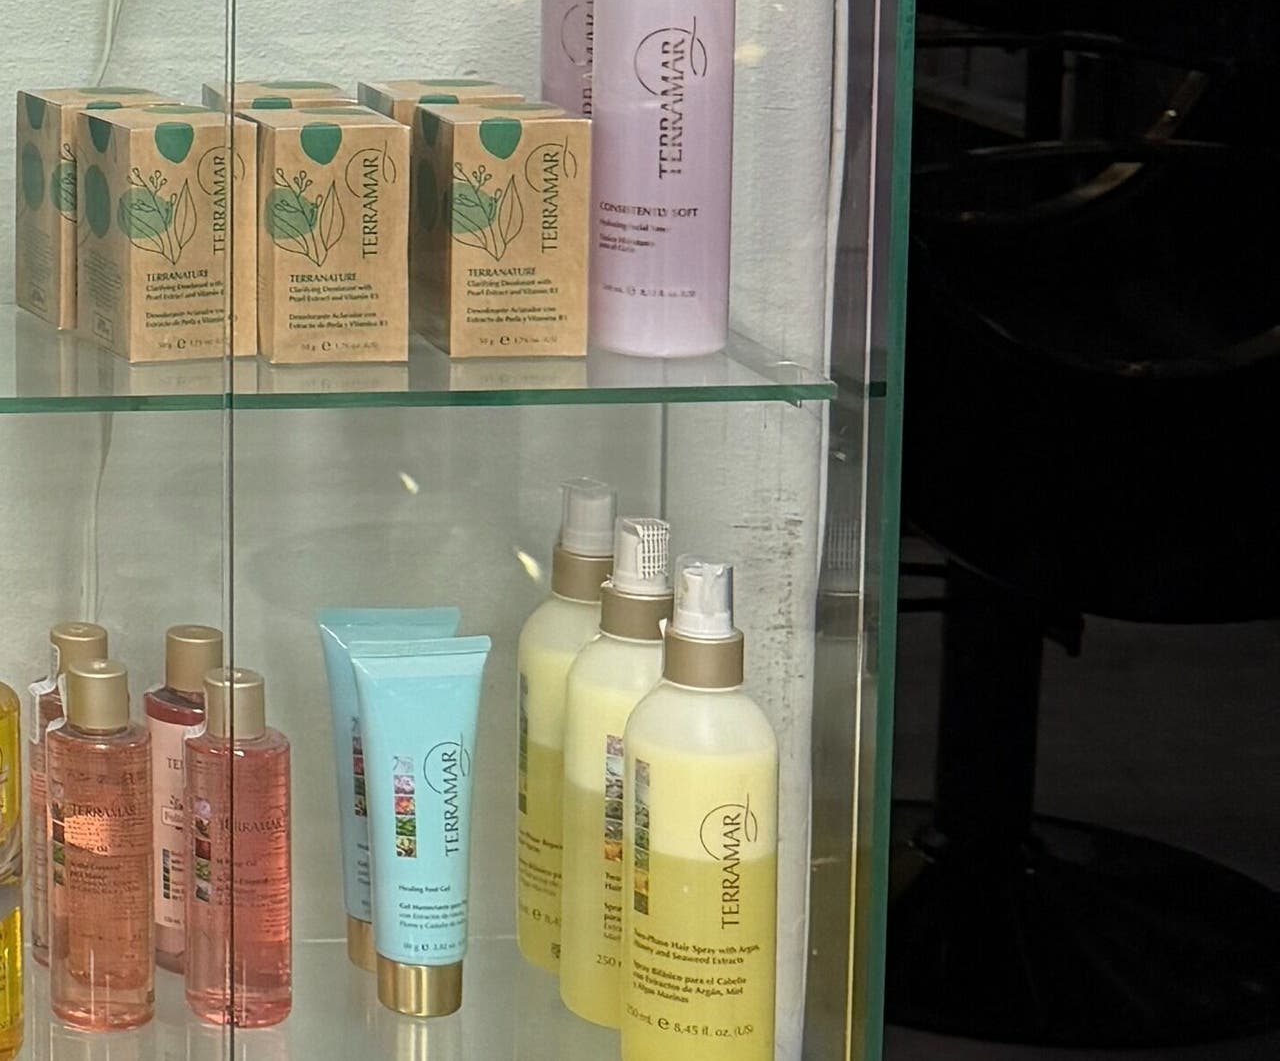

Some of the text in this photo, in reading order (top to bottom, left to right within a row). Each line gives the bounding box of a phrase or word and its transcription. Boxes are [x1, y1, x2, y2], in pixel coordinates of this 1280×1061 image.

[660, 38, 686, 178] TERRAMAR
[212, 155, 227, 256] TERRAMAR
[362, 156, 380, 259] TERRAMAR
[542, 151, 560, 253] TERRAMAR
[672, 208, 698, 218] SOFT
[288, 273, 357, 283] TERRANATURE
[467, 267, 536, 278] TERRANATURE
[441, 748, 460, 857] TERRAMAR
[721, 812, 741, 930] TERRAMAR
[655, 950, 671, 958] and
[671, 941, 690, 951] Hair
[692, 945, 716, 955] Spray
[719, 946, 737, 954] with
[596, 954, 616, 966] 250
[685, 976, 704, 985] para
[717, 977, 747, 985] Cabello
[726, 987, 744, 995] Miel
[674, 1023, 698, 1036] 8.45
